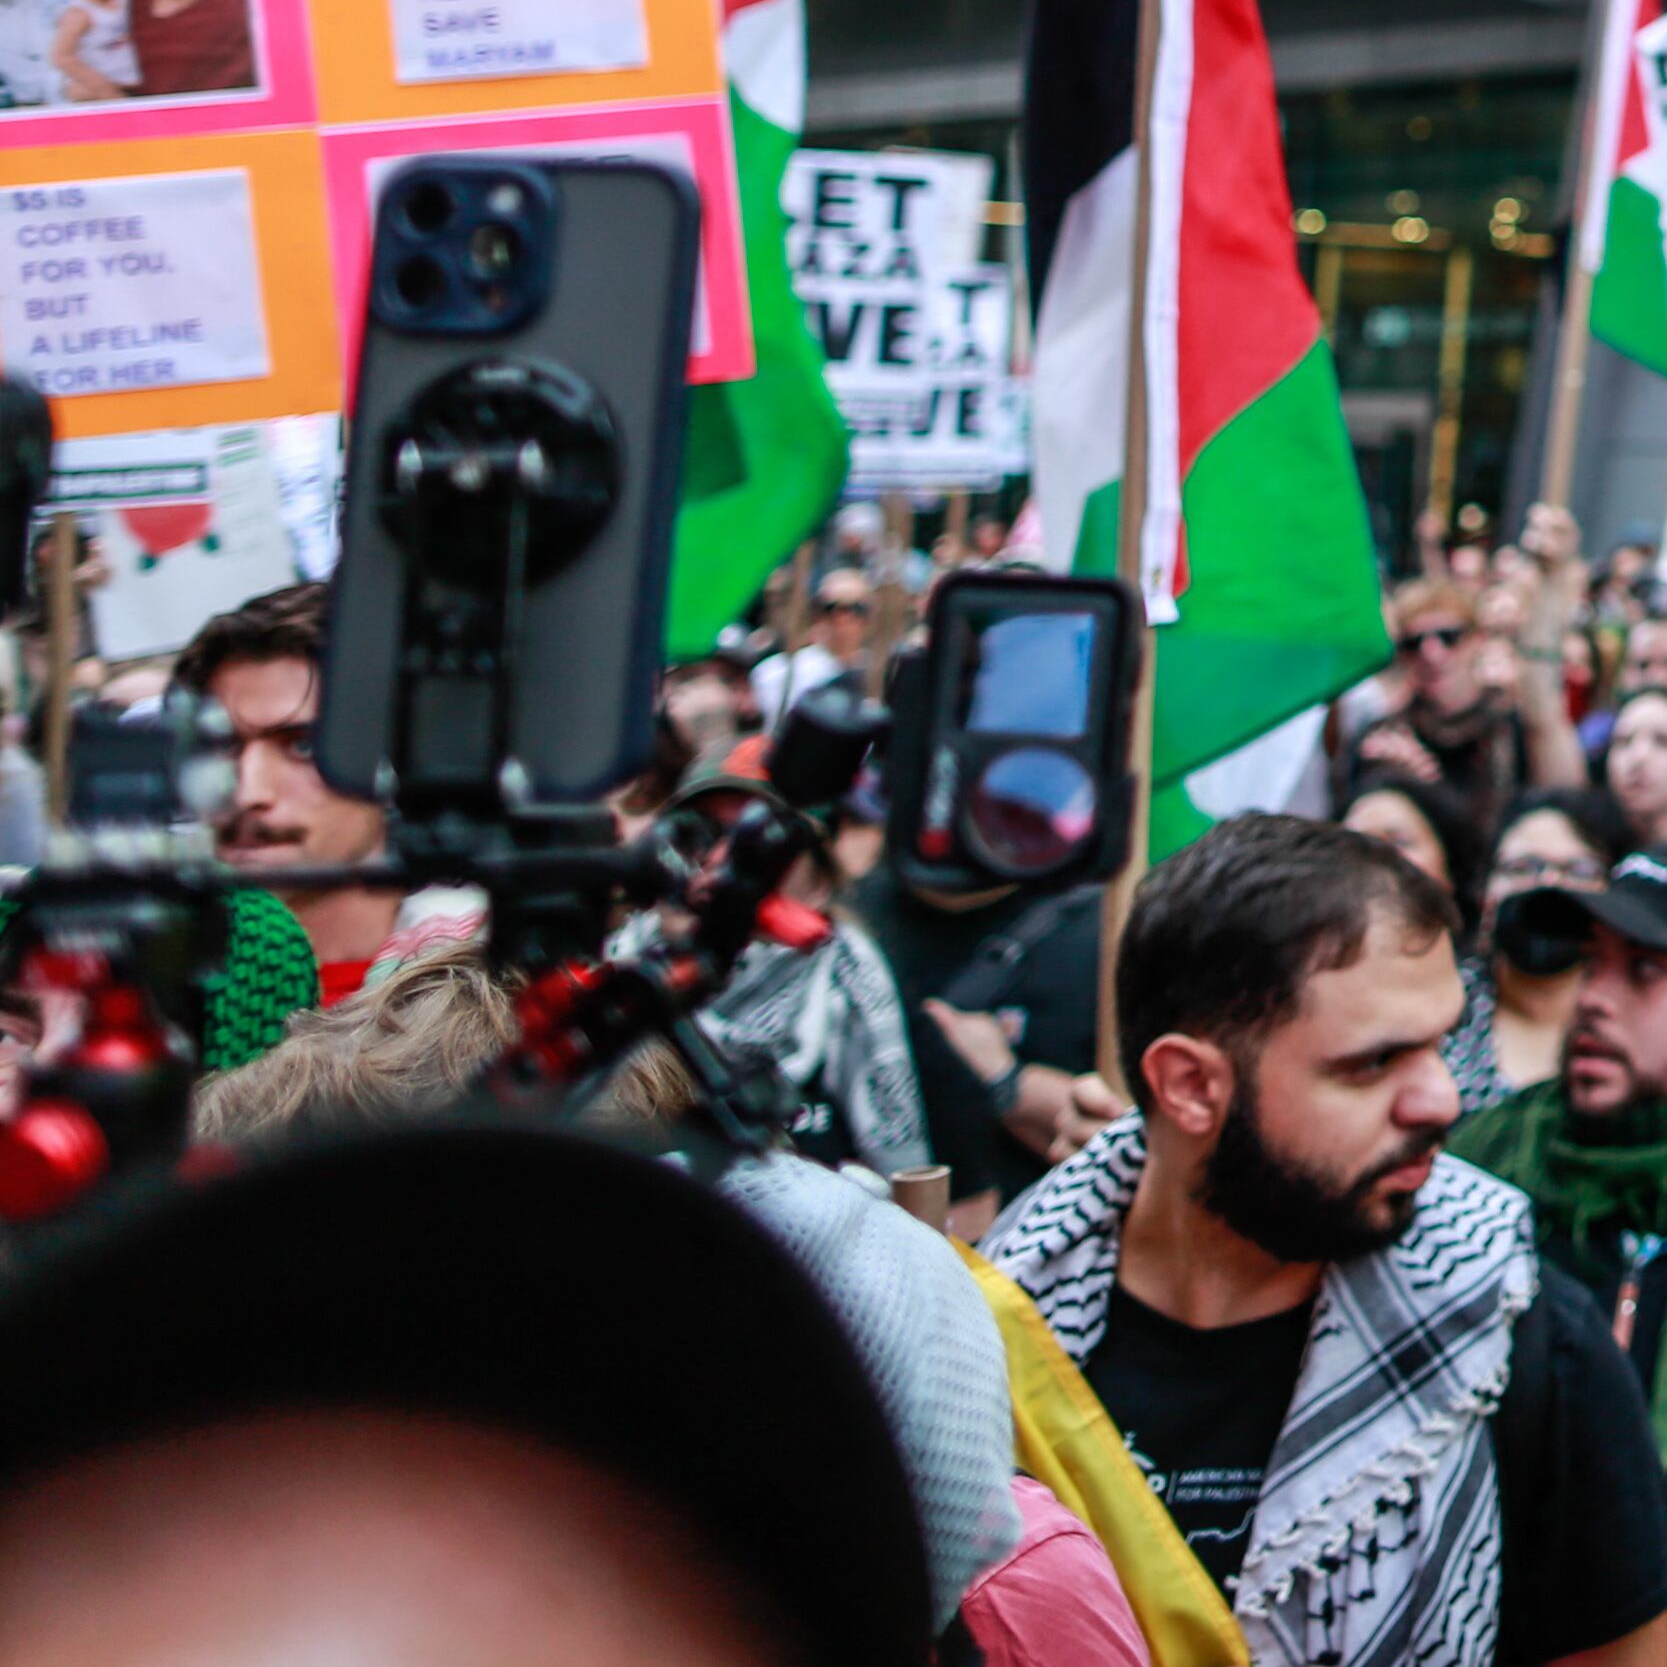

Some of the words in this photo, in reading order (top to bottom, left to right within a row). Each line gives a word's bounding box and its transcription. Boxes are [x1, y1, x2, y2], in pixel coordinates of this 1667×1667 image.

[423, 9, 500, 36] SAVE
[57, 188, 86, 209] IS
[814, 174, 927, 231] ET
[17, 215, 147, 249] COFFEE
[21, 257, 87, 283] FOR
[24, 293, 89, 323] BUT
[30, 335, 51, 356] A
[61, 317, 204, 355] LIFELINE
[34, 365, 98, 391] FOR
[108, 357, 175, 383] HER
